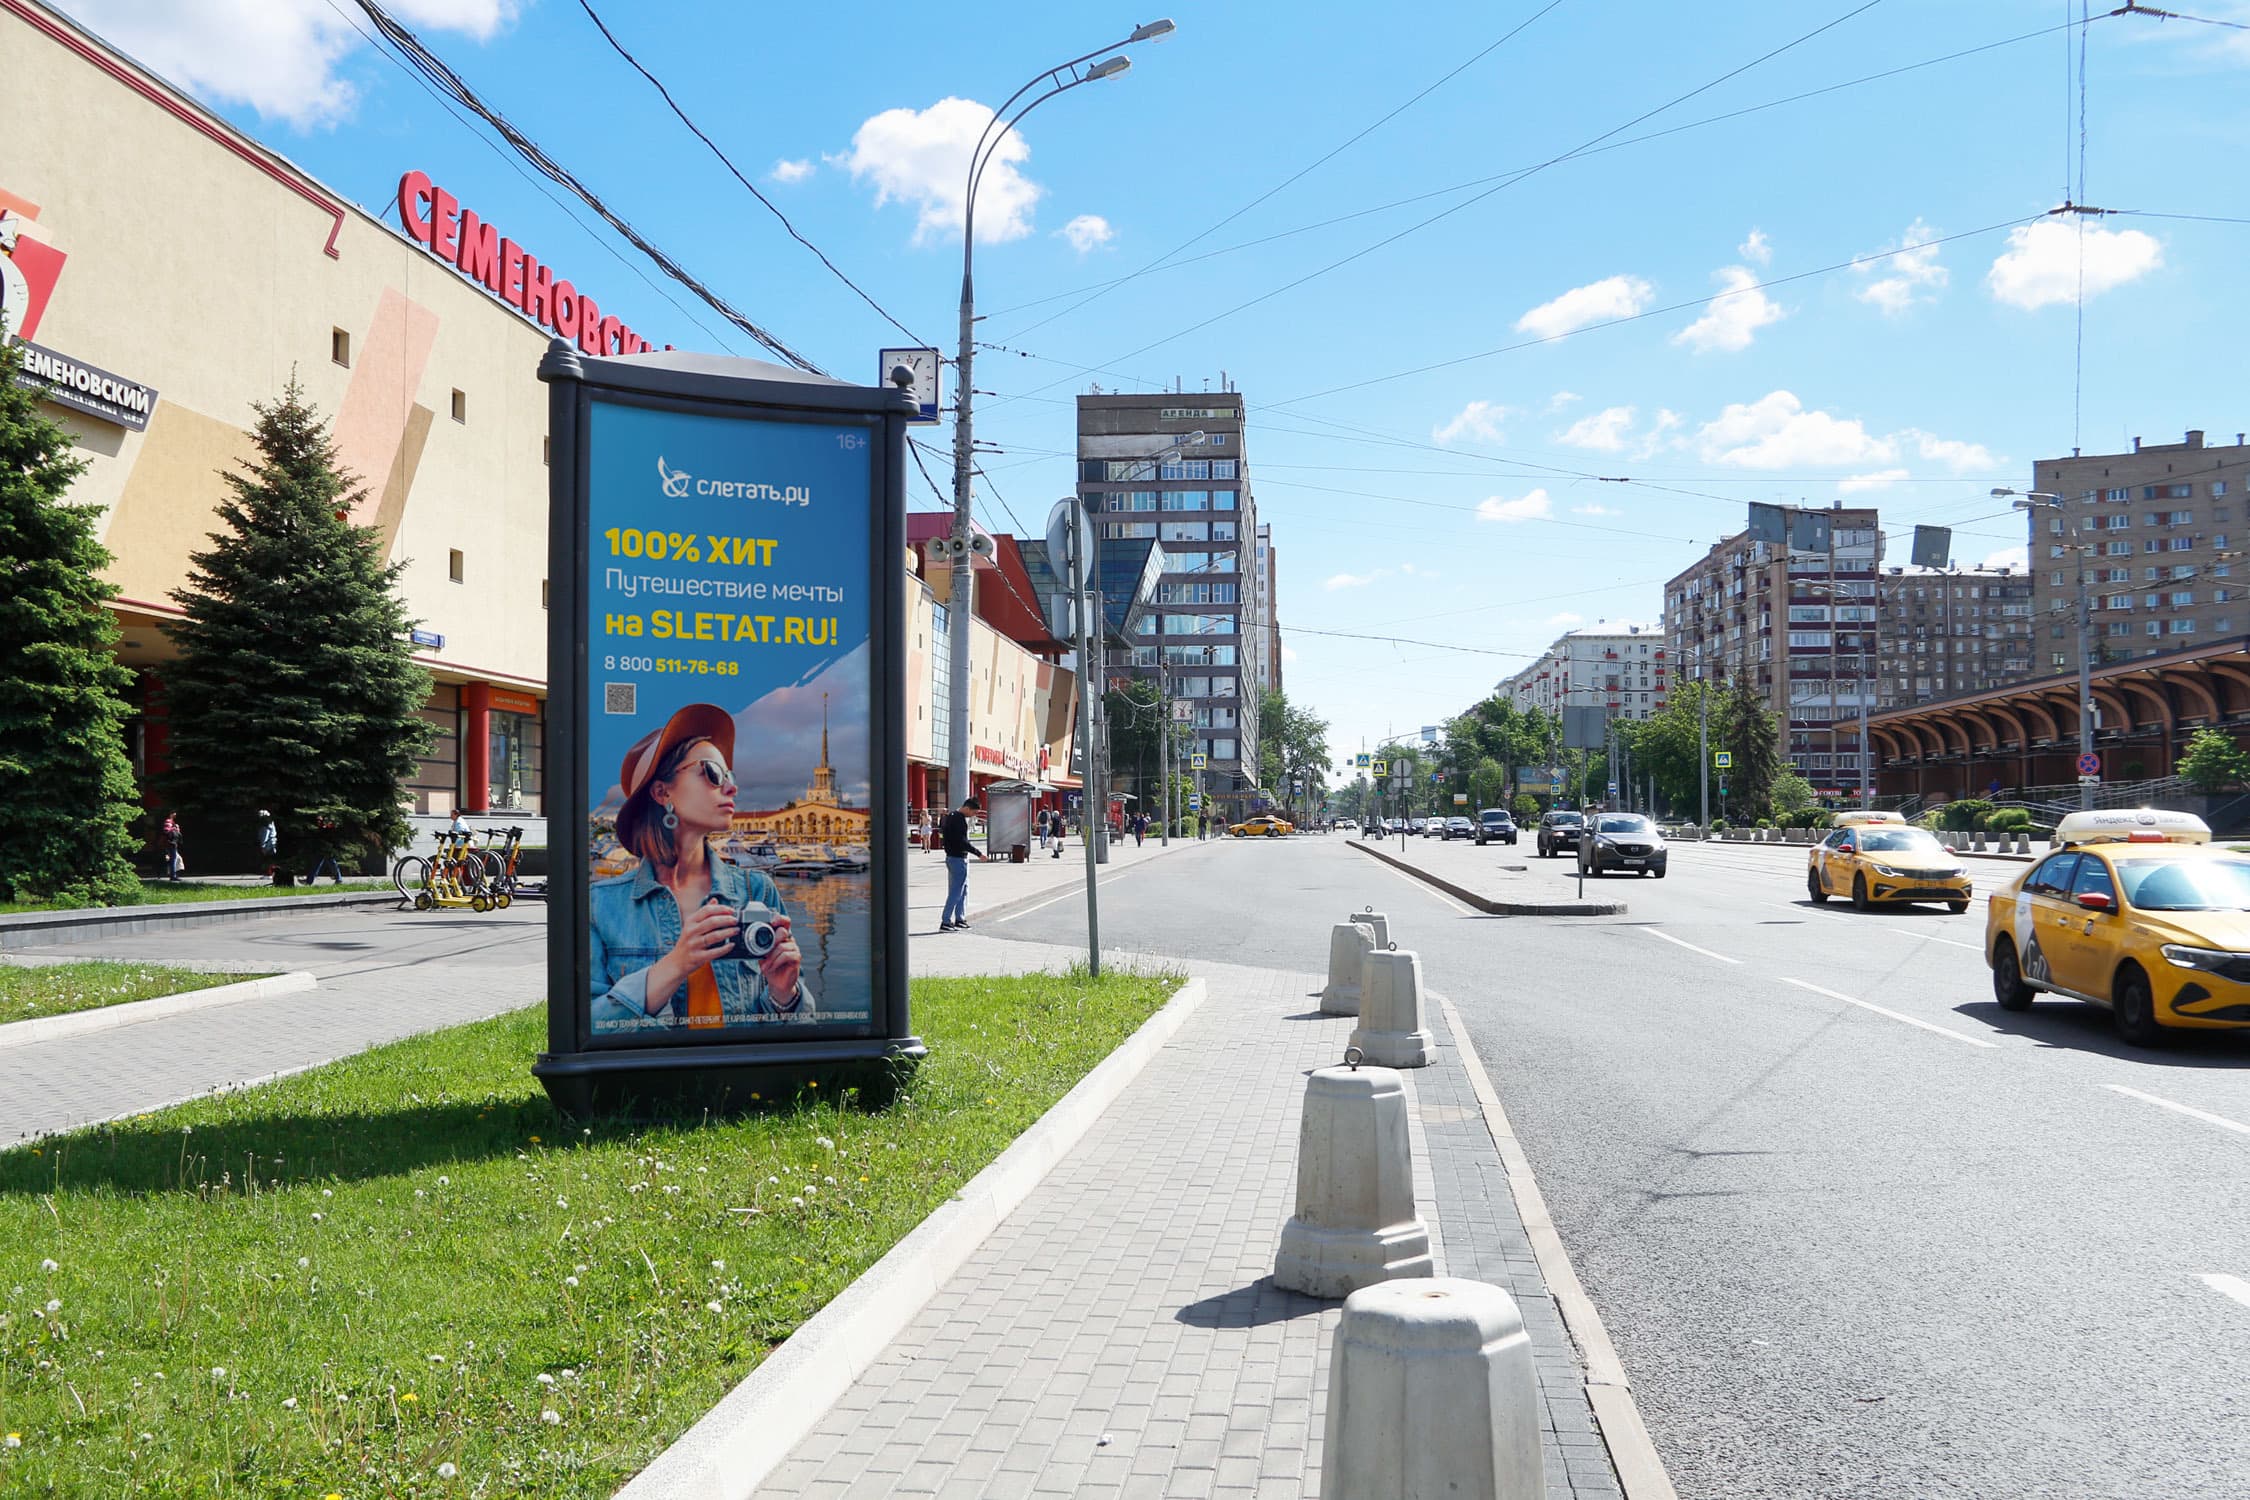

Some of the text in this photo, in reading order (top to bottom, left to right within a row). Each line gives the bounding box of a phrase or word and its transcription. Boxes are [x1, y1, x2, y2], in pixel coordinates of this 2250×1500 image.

[398, 170, 677, 357] СЕМЕНОВСК
[1162, 409, 1208, 417] АРЕНДА
[836, 433, 867, 450] 16+
[696, 477, 810, 507] слетать.ру
[605, 528, 778, 567] 100% ХИТ
[605, 567, 844, 603] Путешествие мечты
[605, 609, 838, 646] на SLETAT.RU!
[603, 655, 739, 676] 8 800 511-76-68
[2093, 816, 2136, 824] Яндекс
